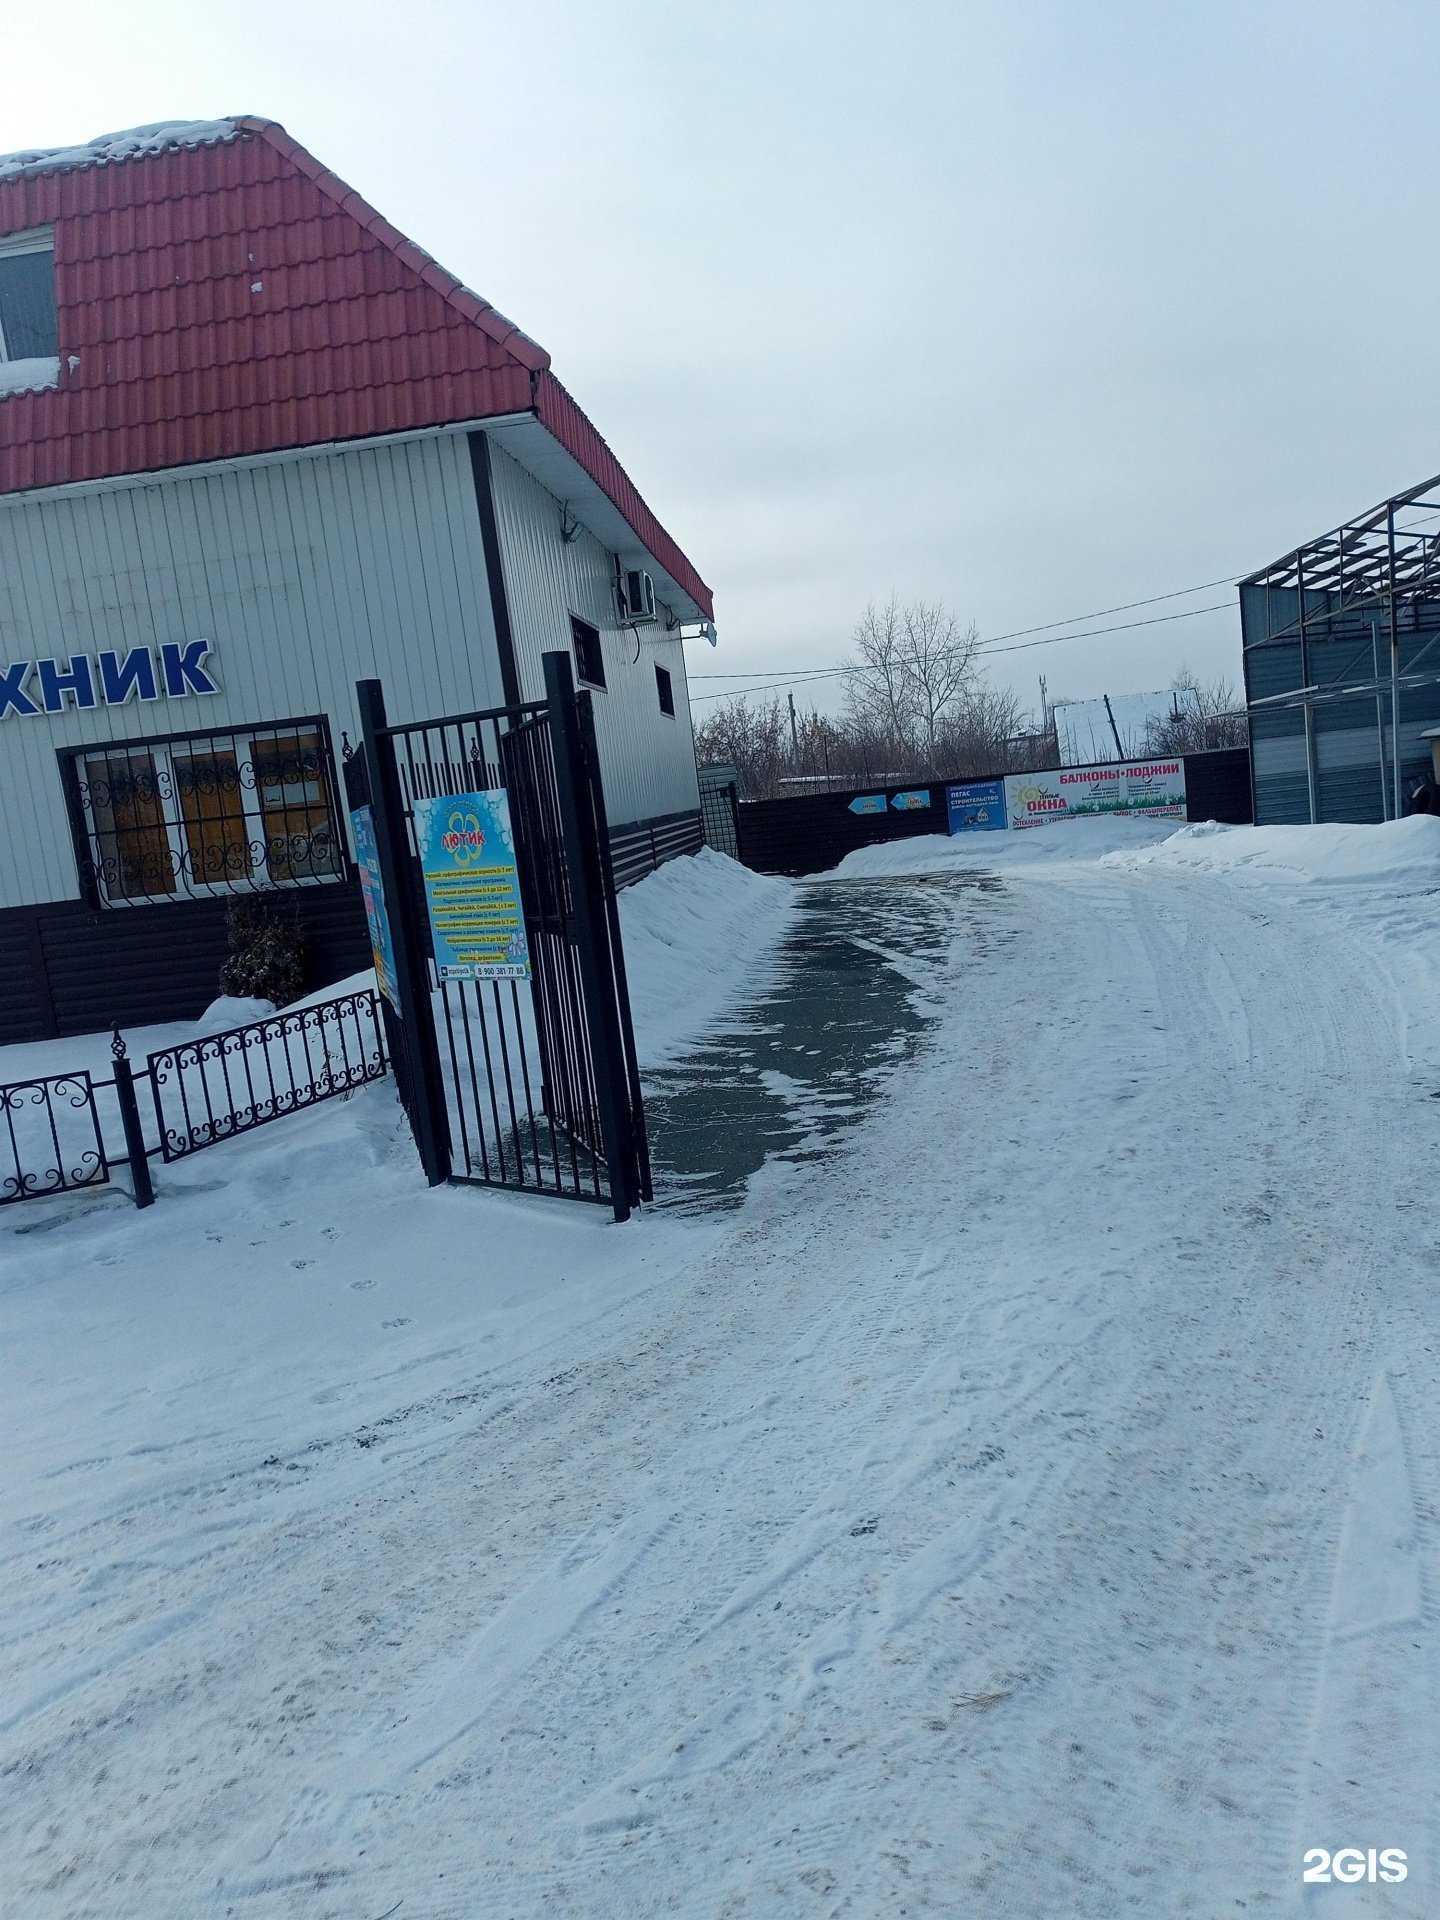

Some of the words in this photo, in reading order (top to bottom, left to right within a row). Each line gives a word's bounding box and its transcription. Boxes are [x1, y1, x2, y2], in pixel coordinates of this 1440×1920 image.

[1060, 770, 1120, 785] БАЛКОНЫ
[1125, 764, 1179, 778] ЛОДЖИИ
[1028, 798, 1067, 811] ОКНА
[442, 831, 486, 849] ЛЮТИК
